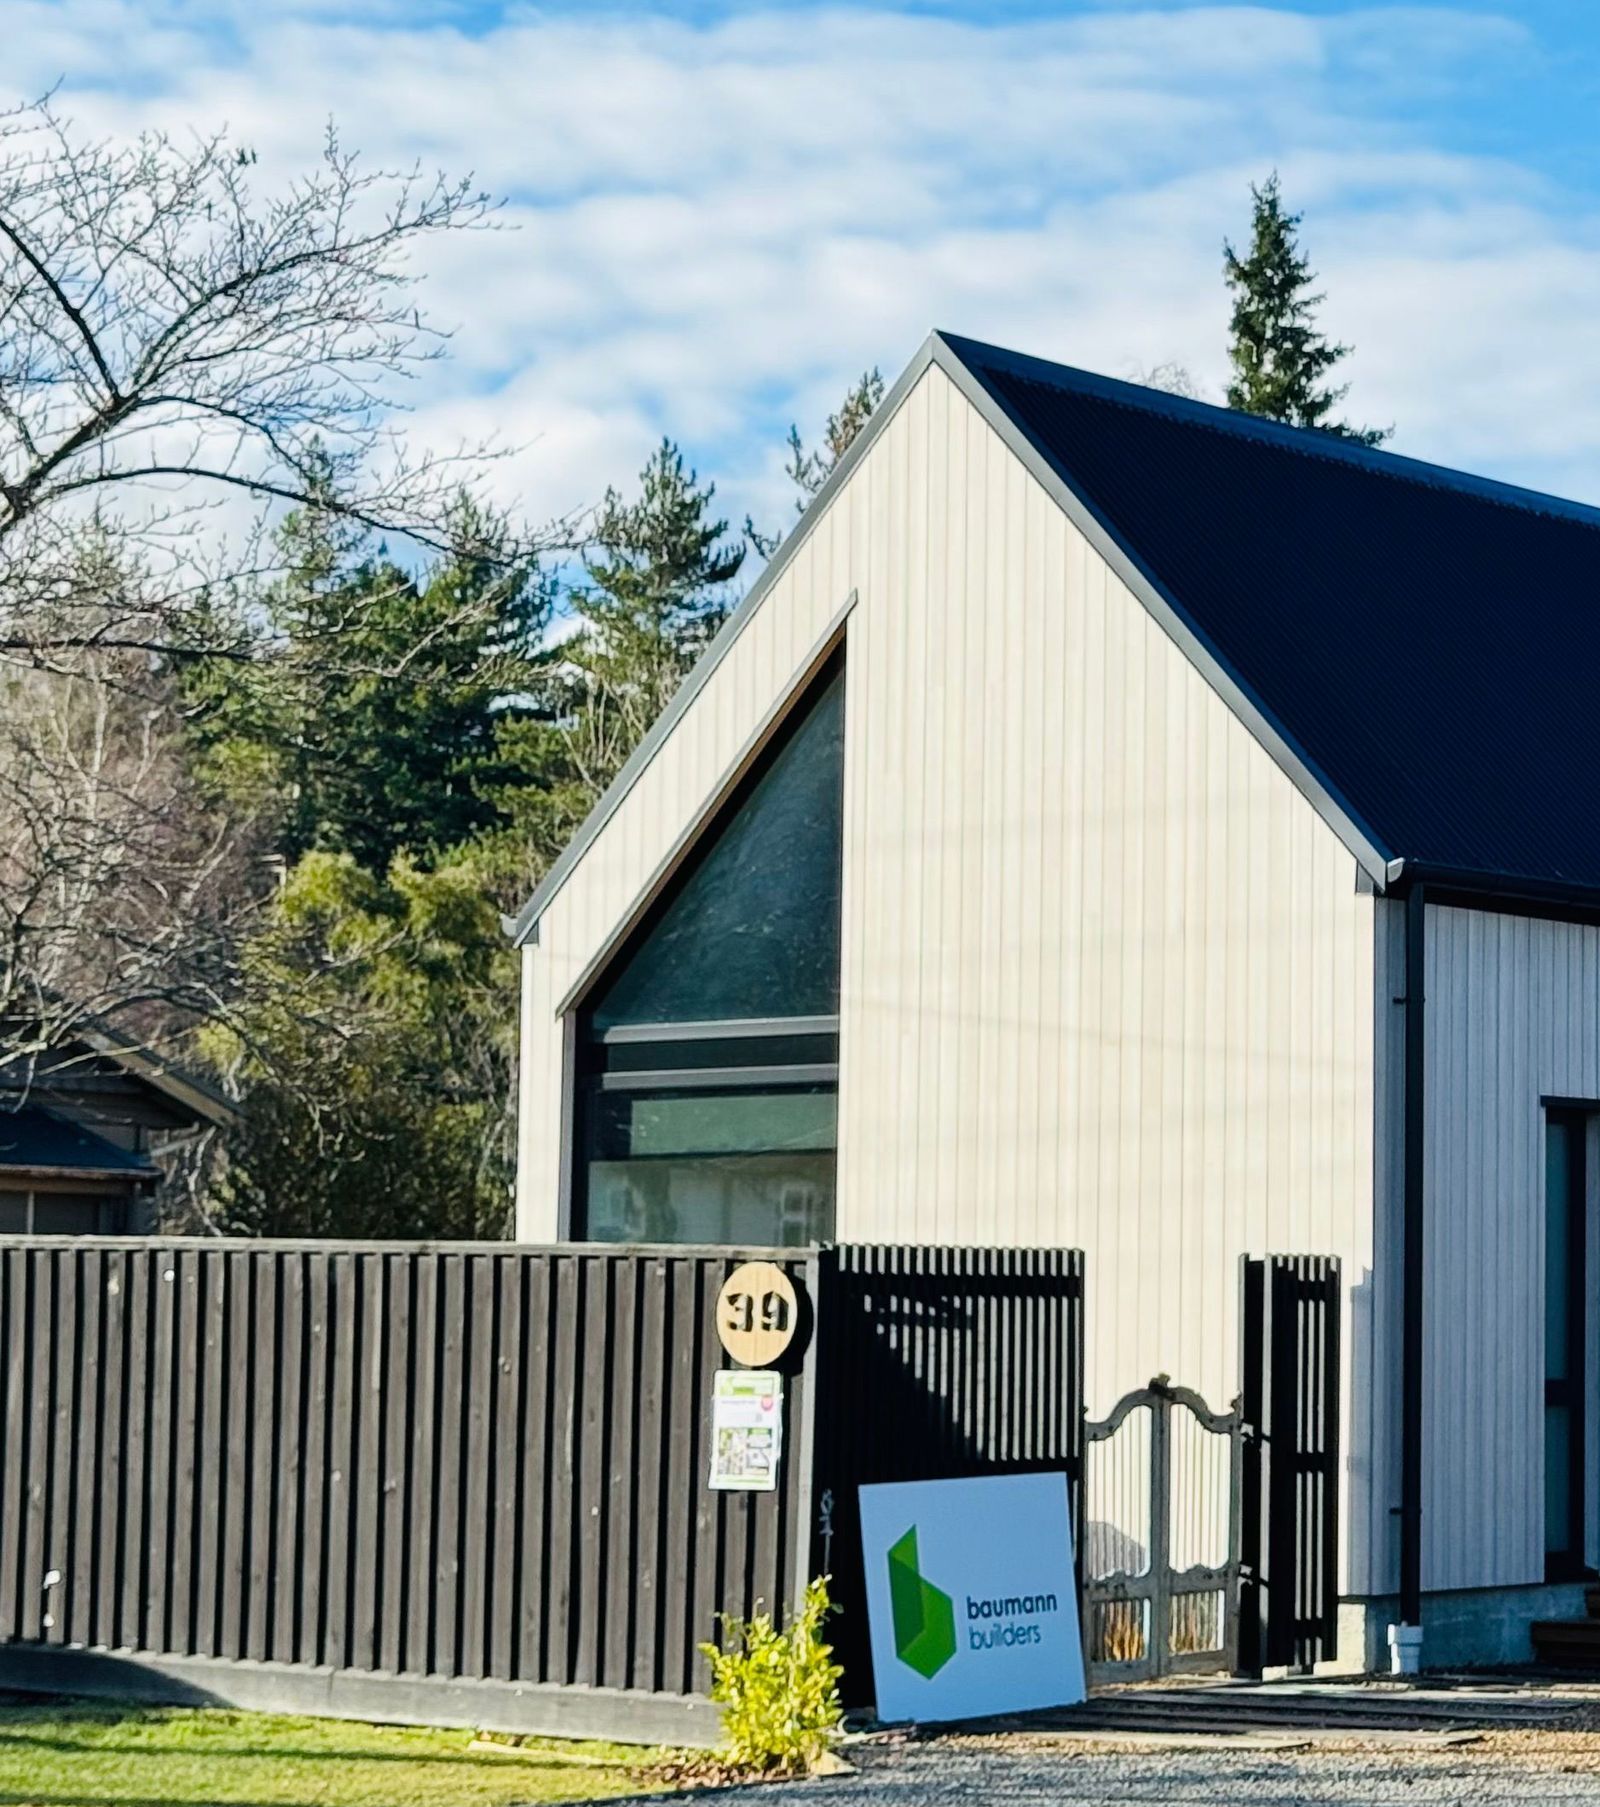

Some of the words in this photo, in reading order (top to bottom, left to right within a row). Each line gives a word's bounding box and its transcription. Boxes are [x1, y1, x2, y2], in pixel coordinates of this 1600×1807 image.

[726, 1291, 789, 1332] 39
[966, 1594, 1058, 1620] baumann
[968, 1622, 1041, 1650] builders
